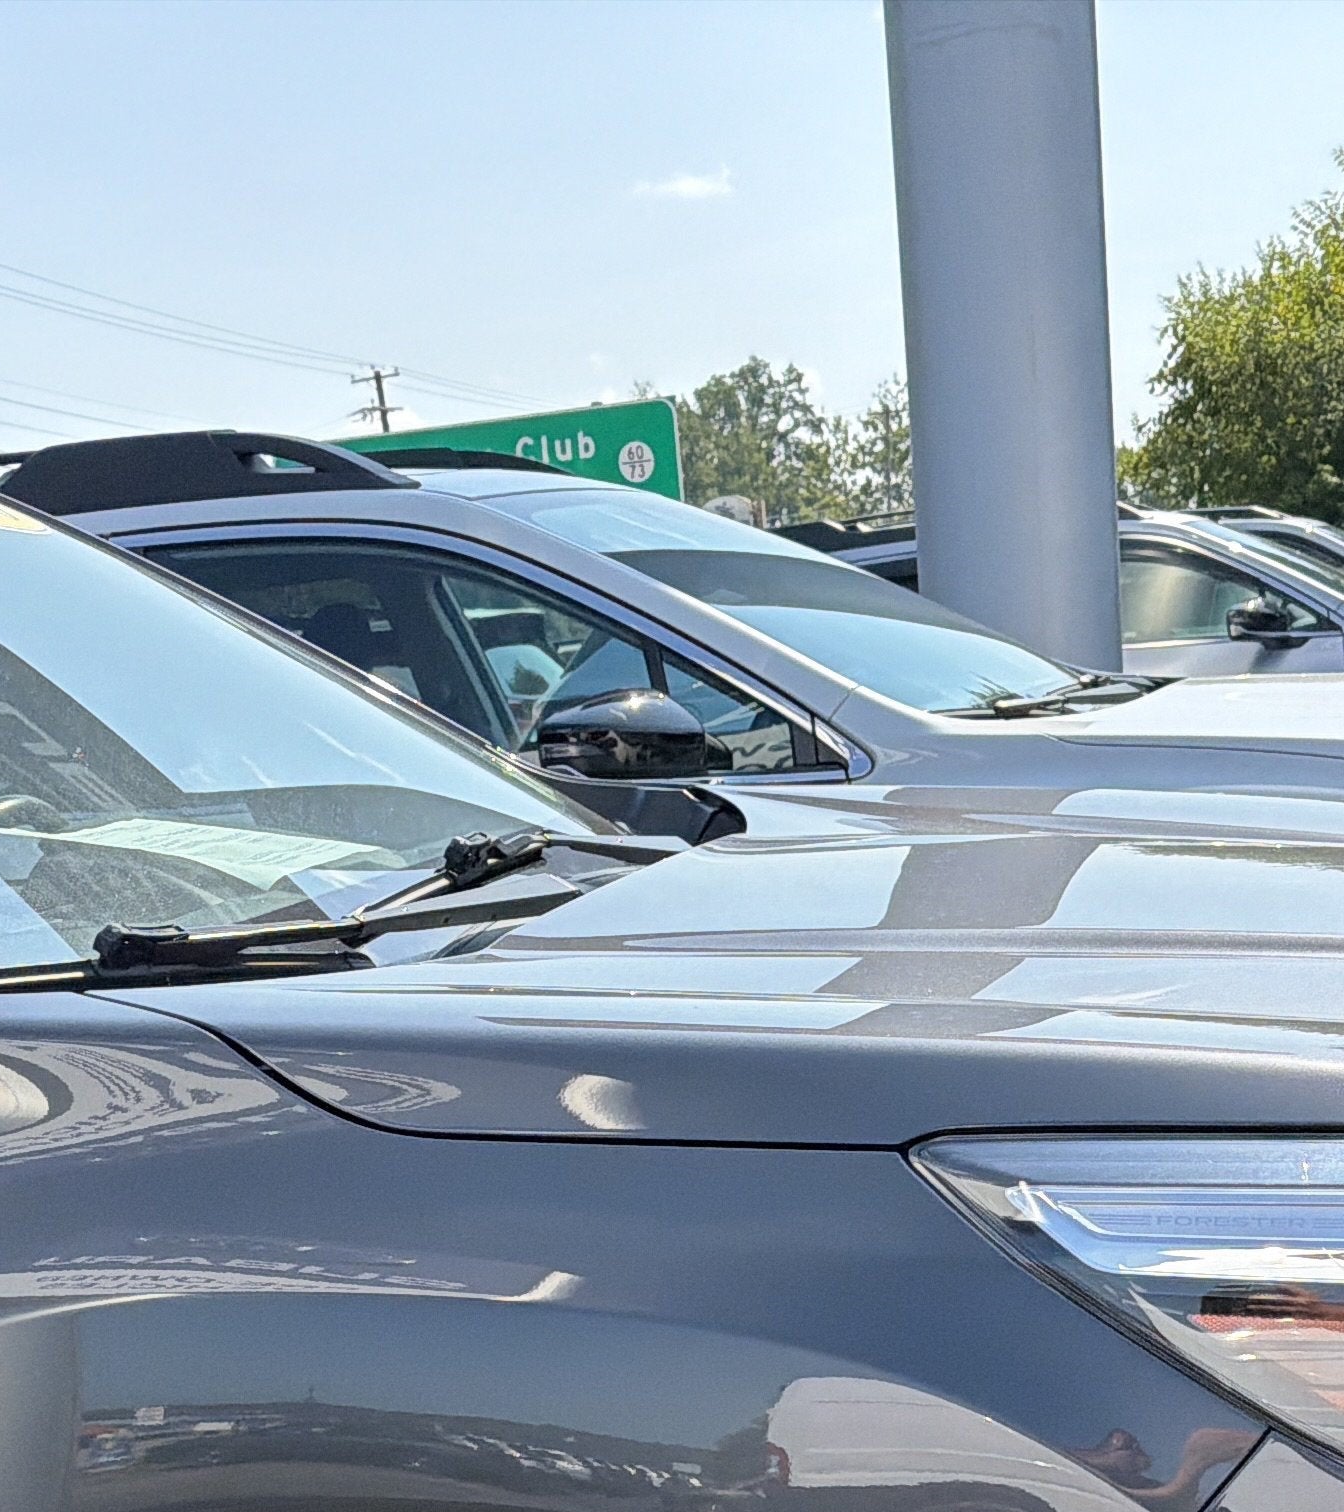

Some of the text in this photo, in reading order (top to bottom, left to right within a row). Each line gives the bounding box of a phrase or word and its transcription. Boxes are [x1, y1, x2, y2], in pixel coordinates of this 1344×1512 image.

[515, 429, 596, 464] Club
[627, 445, 644, 460] 60
[629, 464, 646, 479] 73
[1155, 1214, 1305, 1230] FORESTER
